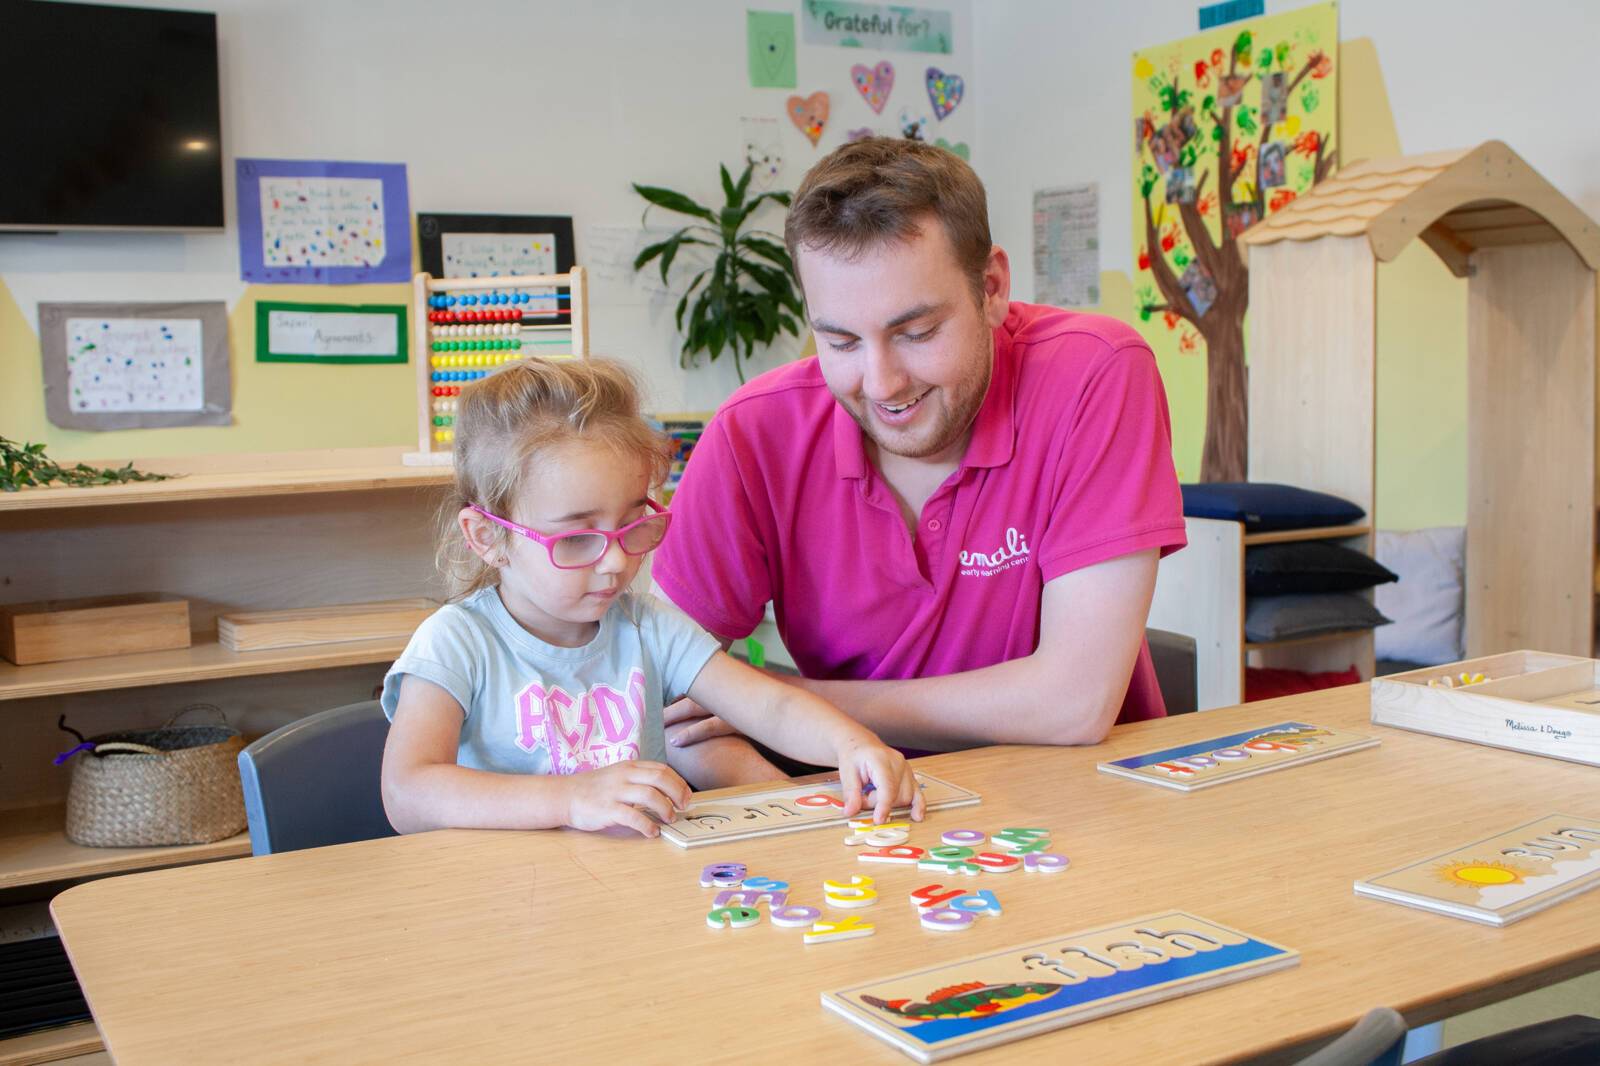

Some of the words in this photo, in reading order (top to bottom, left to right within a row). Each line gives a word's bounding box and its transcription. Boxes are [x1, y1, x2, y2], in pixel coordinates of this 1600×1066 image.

[824, 10, 893, 35] Grateful
[897, 15, 931, 38] for?
[1505, 718, 1538, 731] Melissa
